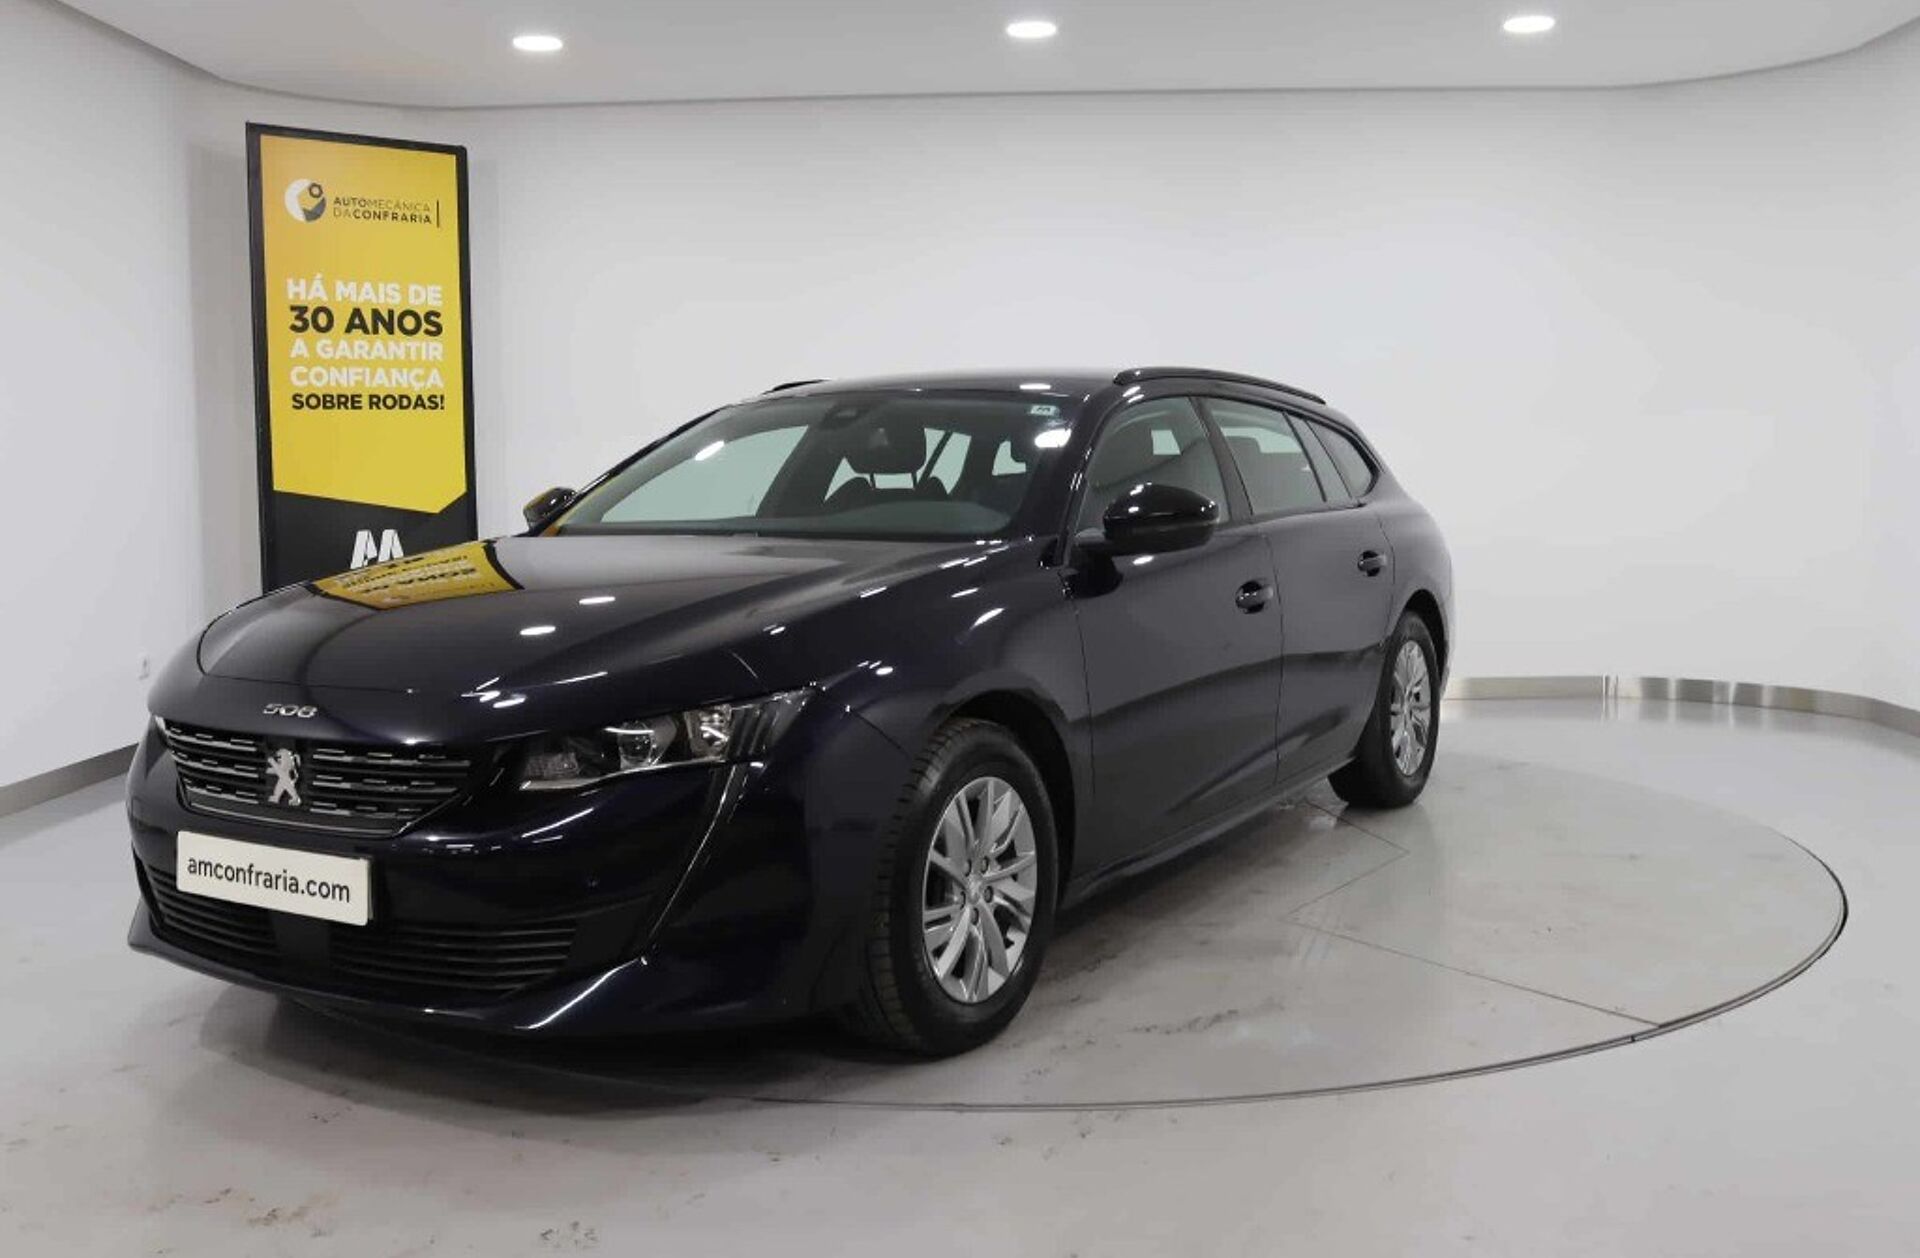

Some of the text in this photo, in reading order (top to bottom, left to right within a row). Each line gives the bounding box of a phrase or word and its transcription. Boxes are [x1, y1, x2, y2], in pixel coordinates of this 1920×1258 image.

[286, 273, 442, 306] HÁ MAIS DE
[289, 305, 443, 337] 30 ANOS
[290, 338, 443, 362] A GARANTIR
[290, 366, 444, 390] CONFIANÇA
[291, 393, 445, 411] SOBRE RODAS!
[262, 703, 318, 718] 508
[187, 855, 351, 903] amconfraria.com
